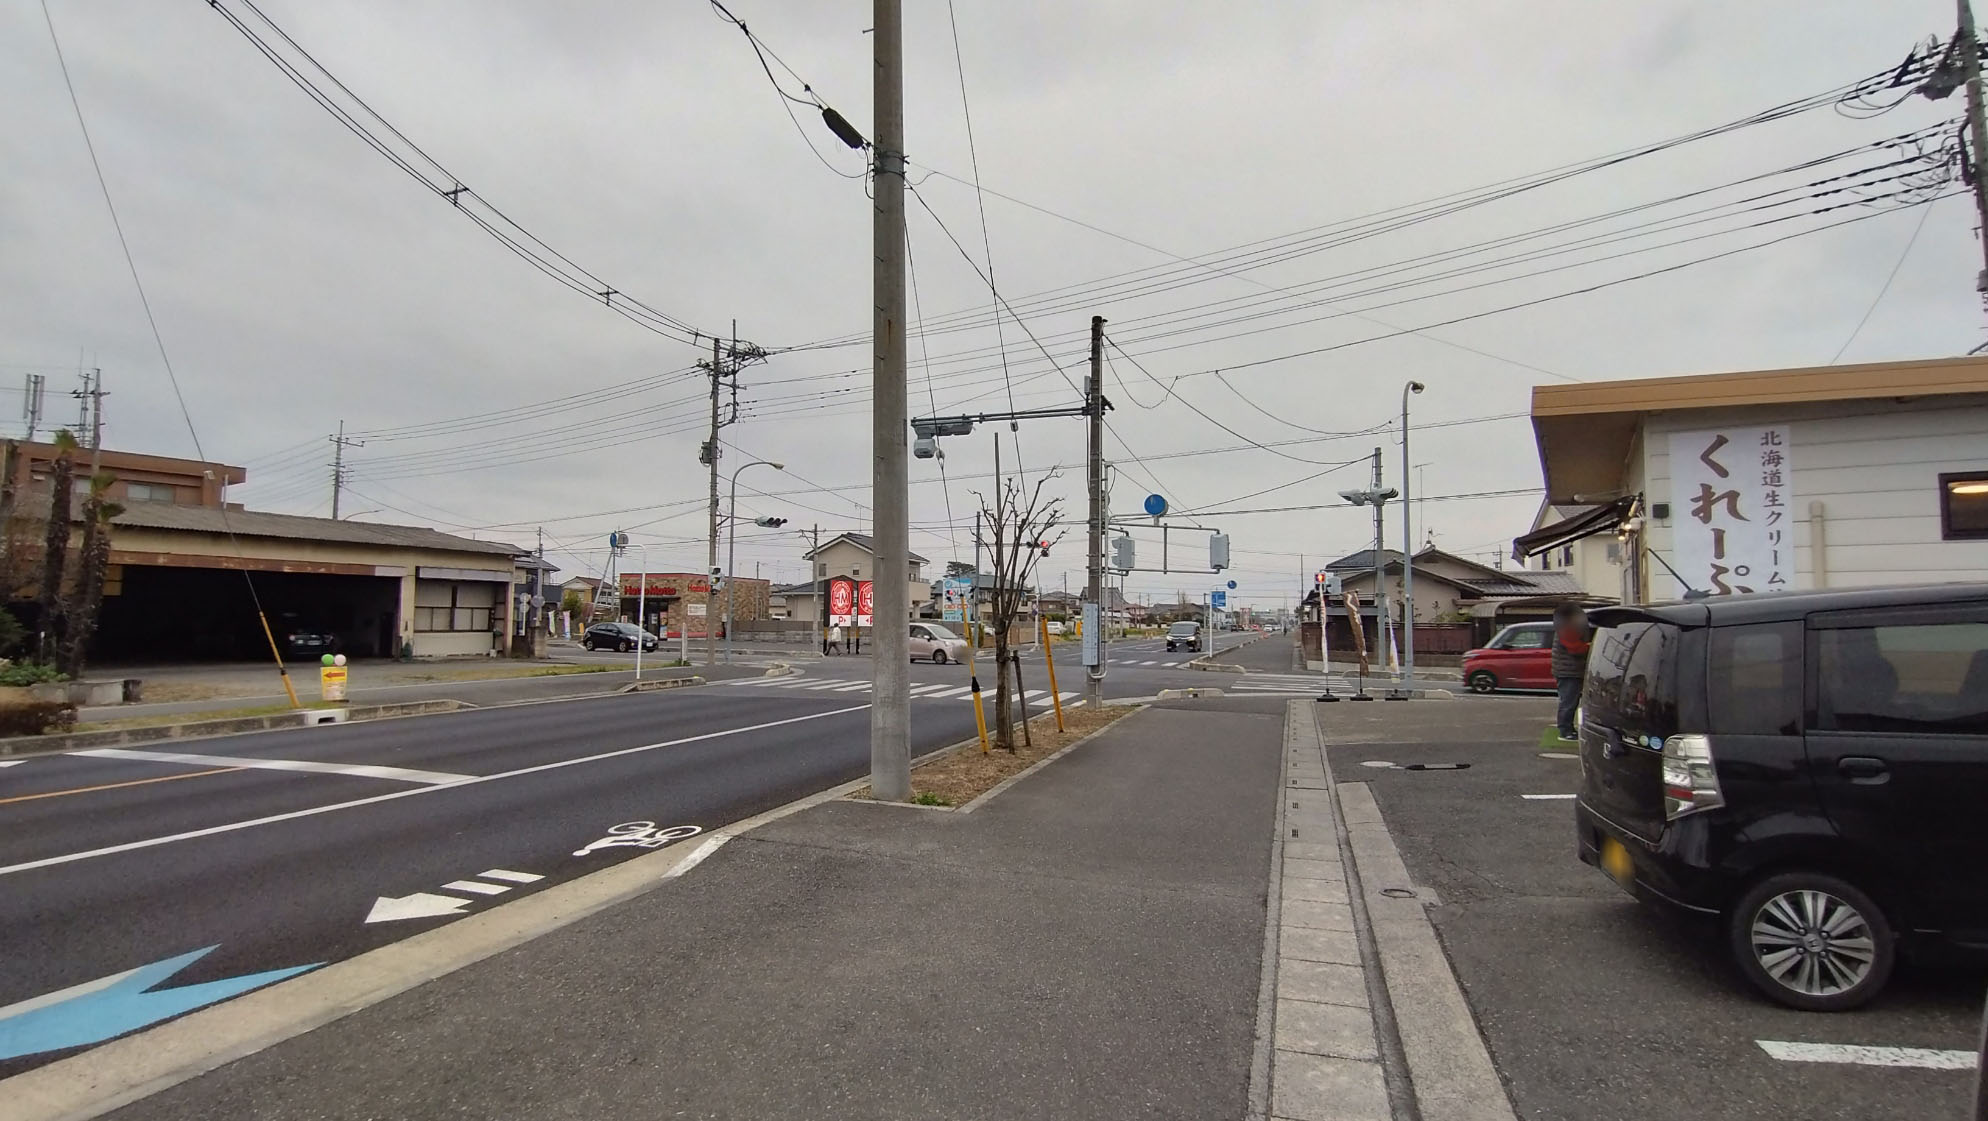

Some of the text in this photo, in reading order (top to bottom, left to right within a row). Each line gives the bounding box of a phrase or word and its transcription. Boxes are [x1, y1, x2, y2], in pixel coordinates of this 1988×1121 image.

[1690, 434, 1754, 596] くれーぷ
[1760, 430, 1786, 592] 北海道生クリーム
